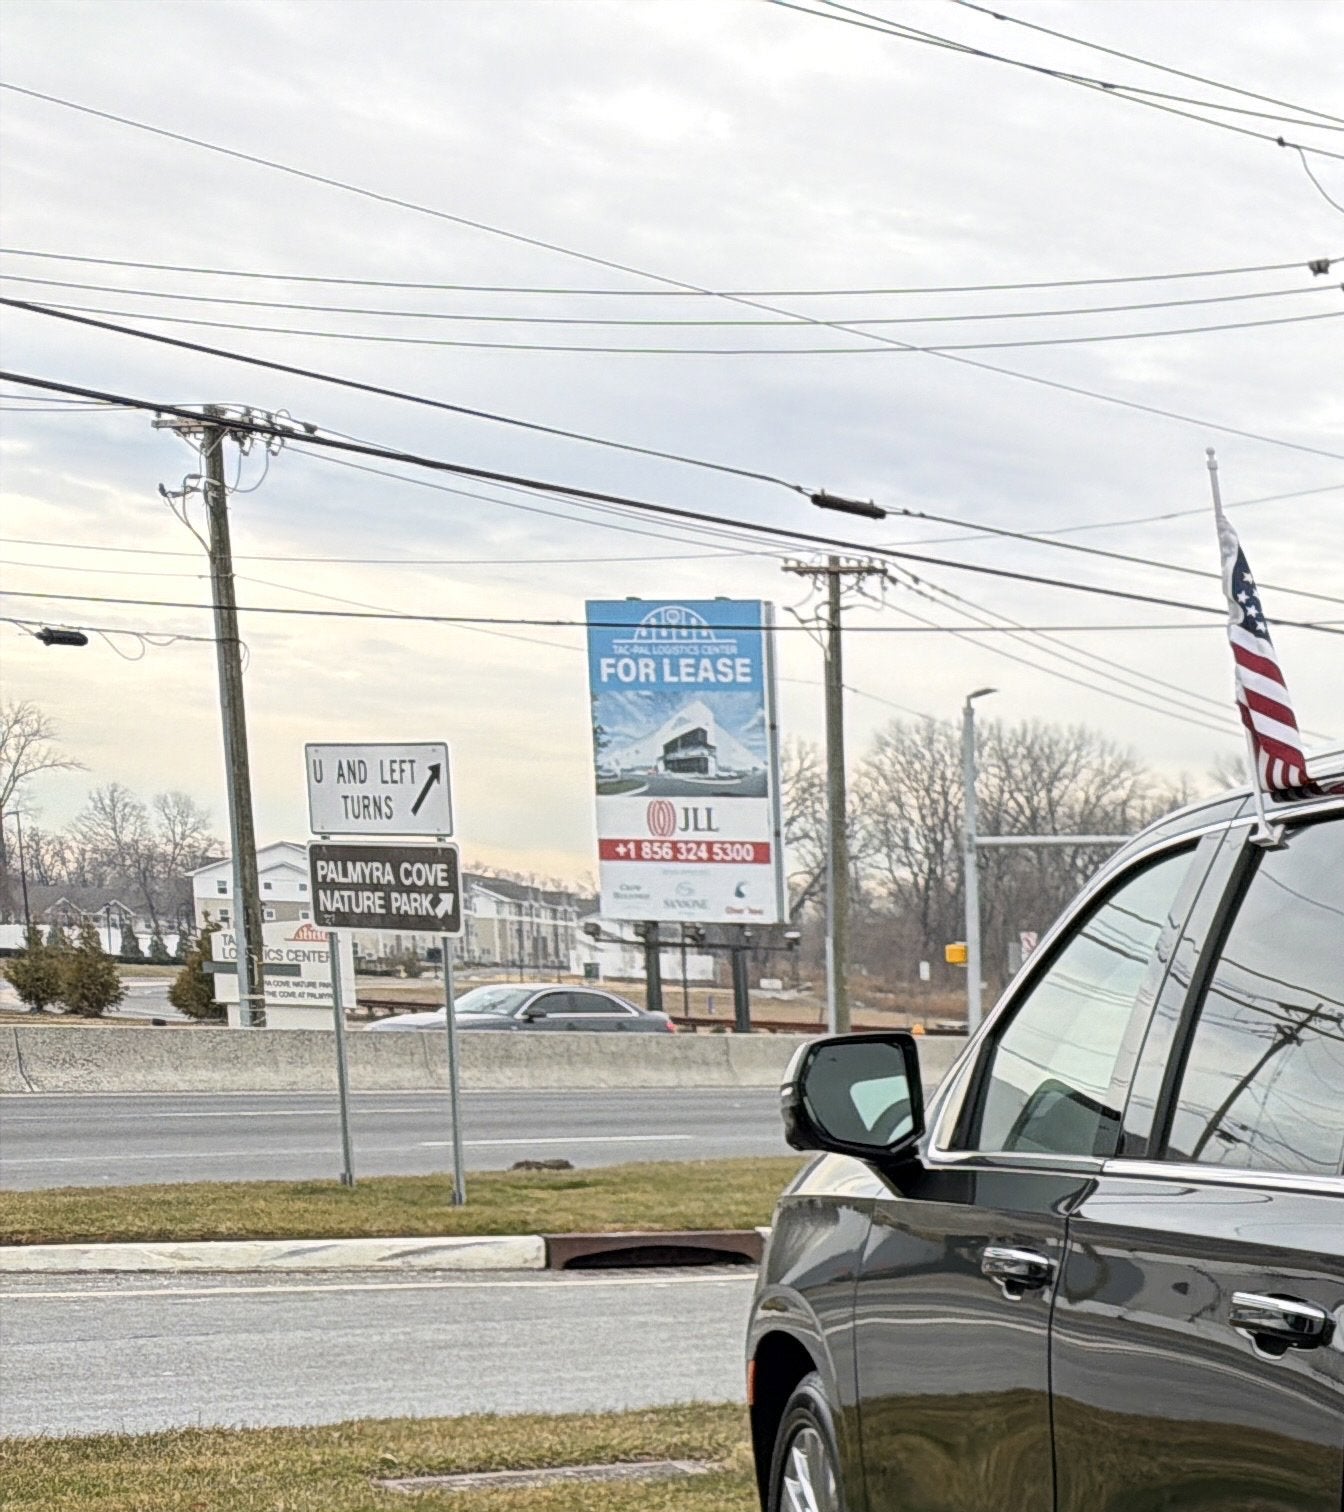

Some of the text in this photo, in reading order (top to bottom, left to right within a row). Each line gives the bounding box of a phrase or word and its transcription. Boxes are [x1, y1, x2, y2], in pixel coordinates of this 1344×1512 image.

[653, 645, 700, 655] LOGISTICS
[702, 645, 738, 655] CENTER
[601, 658, 752, 683] FOR LEASE
[312, 759, 416, 784] U AND LEFT
[341, 795, 394, 820] TURNS
[679, 807, 720, 832] JLL
[615, 841, 754, 861] +1 856 324 5300
[316, 860, 450, 887] PALMYRA COVE
[318, 889, 436, 916] NATURE PARK
